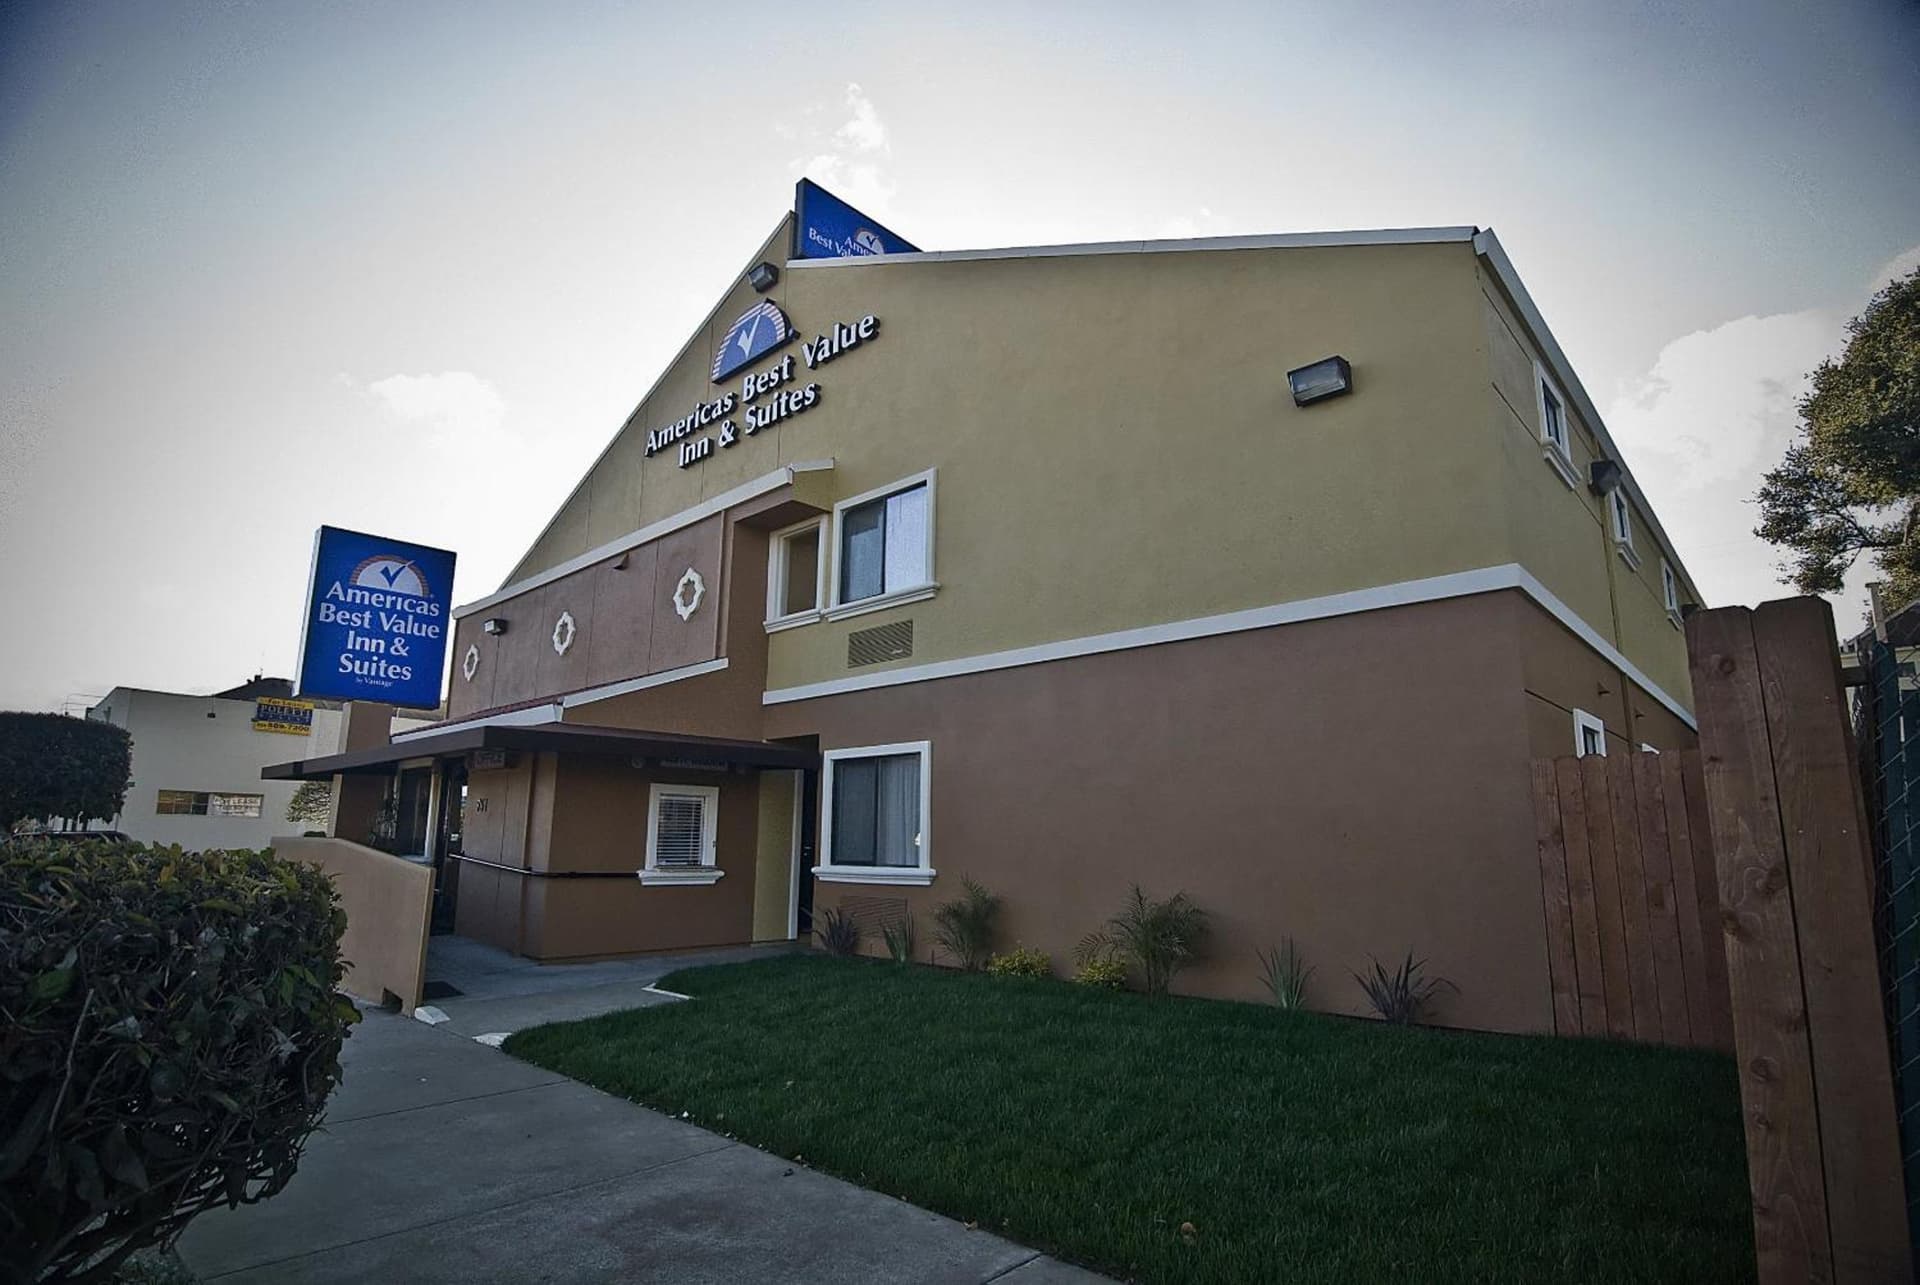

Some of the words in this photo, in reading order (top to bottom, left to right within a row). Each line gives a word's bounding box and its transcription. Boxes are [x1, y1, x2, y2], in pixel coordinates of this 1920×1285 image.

[809, 227, 832, 250] Best
[645, 392, 736, 457] Americas
[742, 355, 792, 402] Best
[802, 315, 877, 368] Value
[679, 437, 710, 467] Inn
[718, 420, 736, 448] &
[745, 383, 818, 434] Suites
[326, 580, 440, 617] Americas
[319, 602, 373, 629] Best
[379, 611, 440, 639] Value
[347, 630, 386, 654] Inn
[389, 636, 410, 656] &
[338, 653, 413, 681] Suites
[364, 677, 393, 688] Vantage
